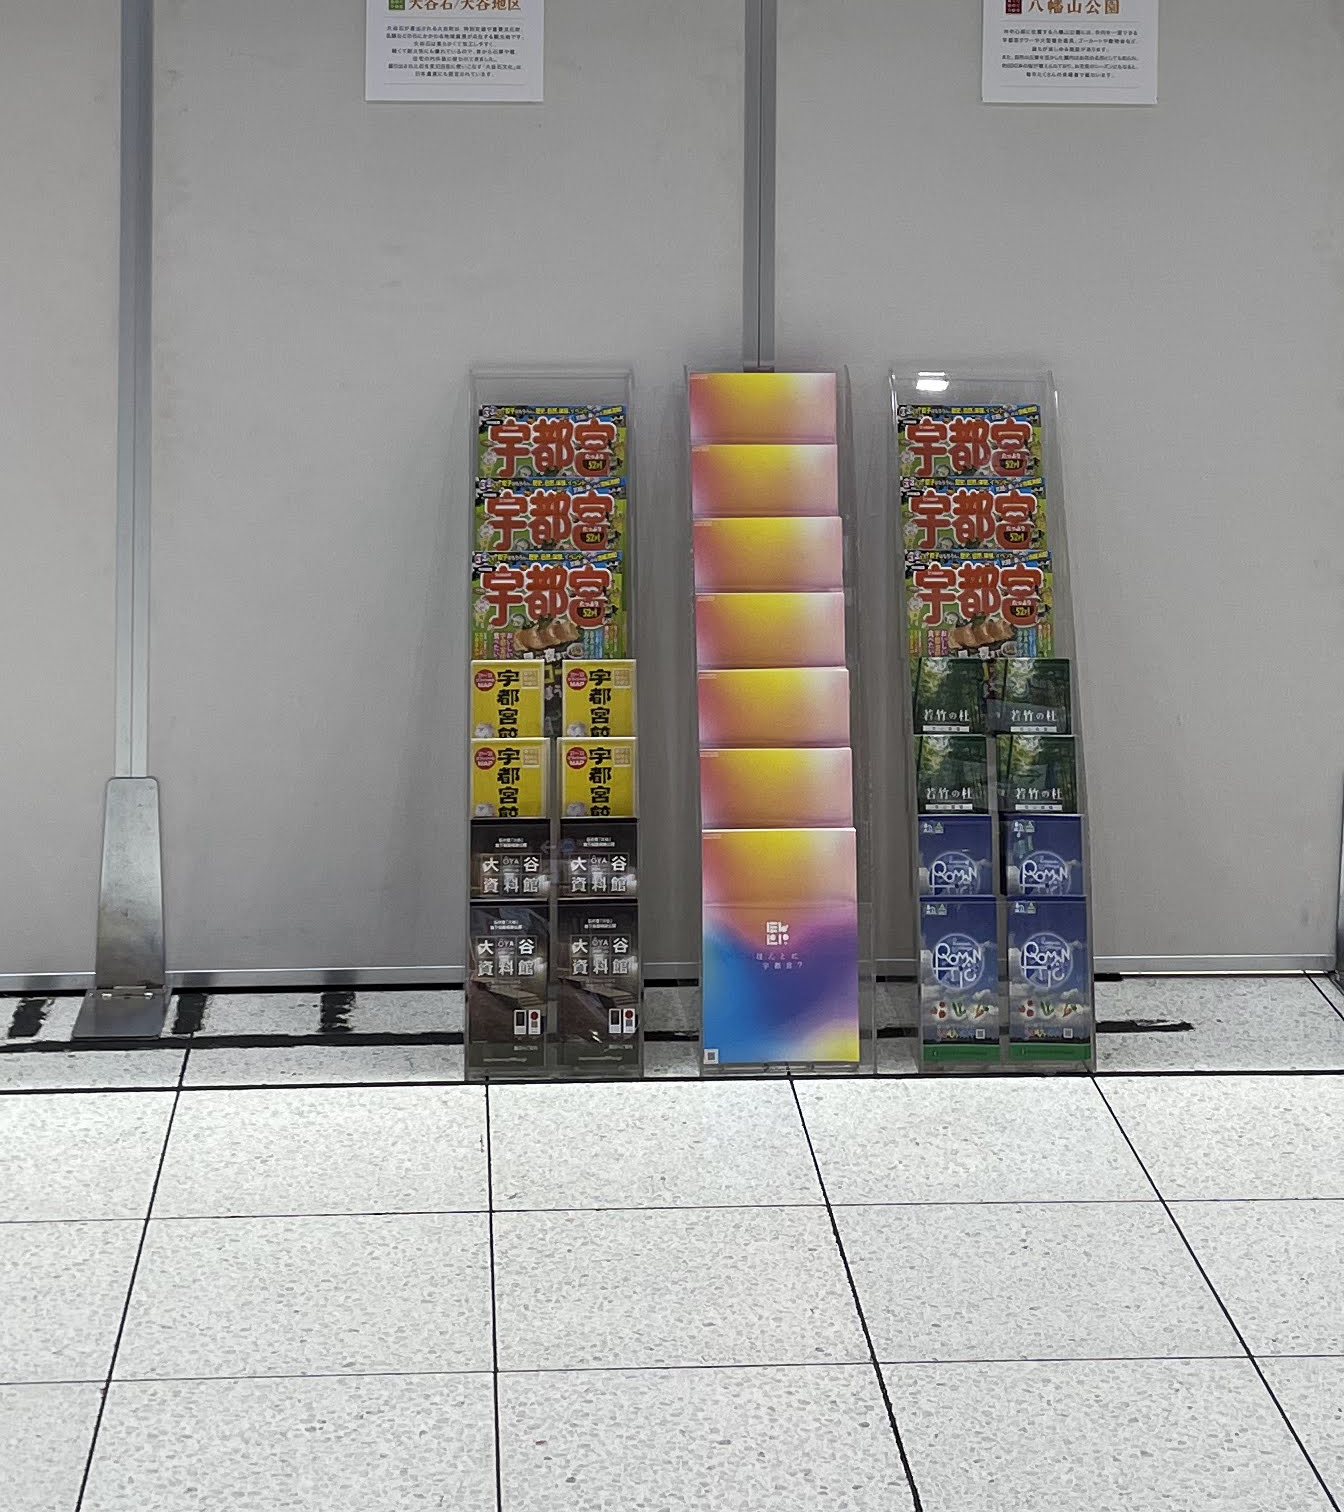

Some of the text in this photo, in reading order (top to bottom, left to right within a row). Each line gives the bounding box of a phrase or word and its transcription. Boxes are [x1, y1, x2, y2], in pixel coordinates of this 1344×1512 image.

[488, 417, 616, 477] 宇都宮
[905, 416, 1032, 477] 宇都宮
[485, 489, 615, 551] 宇都宮
[909, 488, 1037, 551] 宇都宮
[481, 563, 612, 629] 宇都宮
[913, 561, 1044, 627] 宇都宮
